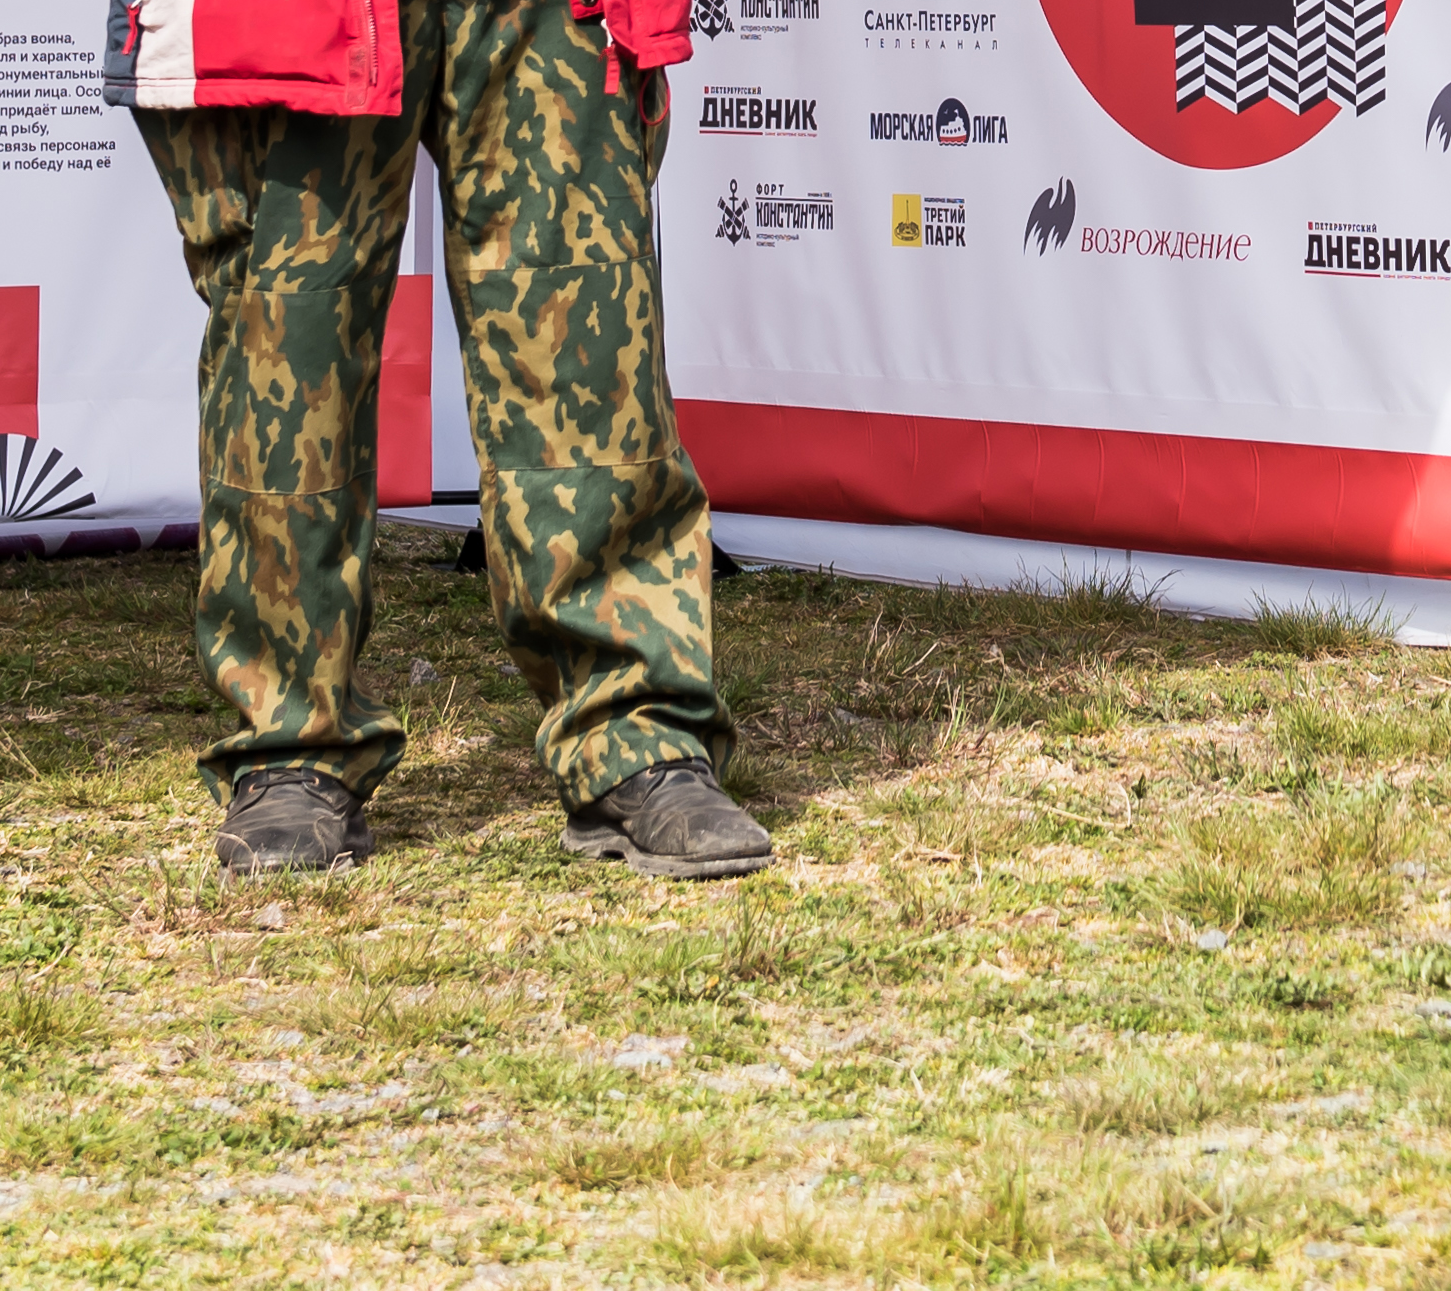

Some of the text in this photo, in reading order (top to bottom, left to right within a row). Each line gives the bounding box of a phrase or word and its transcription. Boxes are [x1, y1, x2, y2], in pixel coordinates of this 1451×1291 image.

[711, 86, 761, 95] ПЕТЕРБУРГСКИЙ
[699, 97, 817, 131] ДНЕВНИК
[870, 113, 1008, 144] МОРСКАЯ ЛИГА
[756, 183, 784, 196] ФОРТ
[756, 202, 833, 230] КОНСТАНТИН
[924, 205, 965, 224] ТРЕТИЙ
[925, 224, 966, 247] ПАРК
[1303, 233, 1451, 274] ДНЕВНИК
